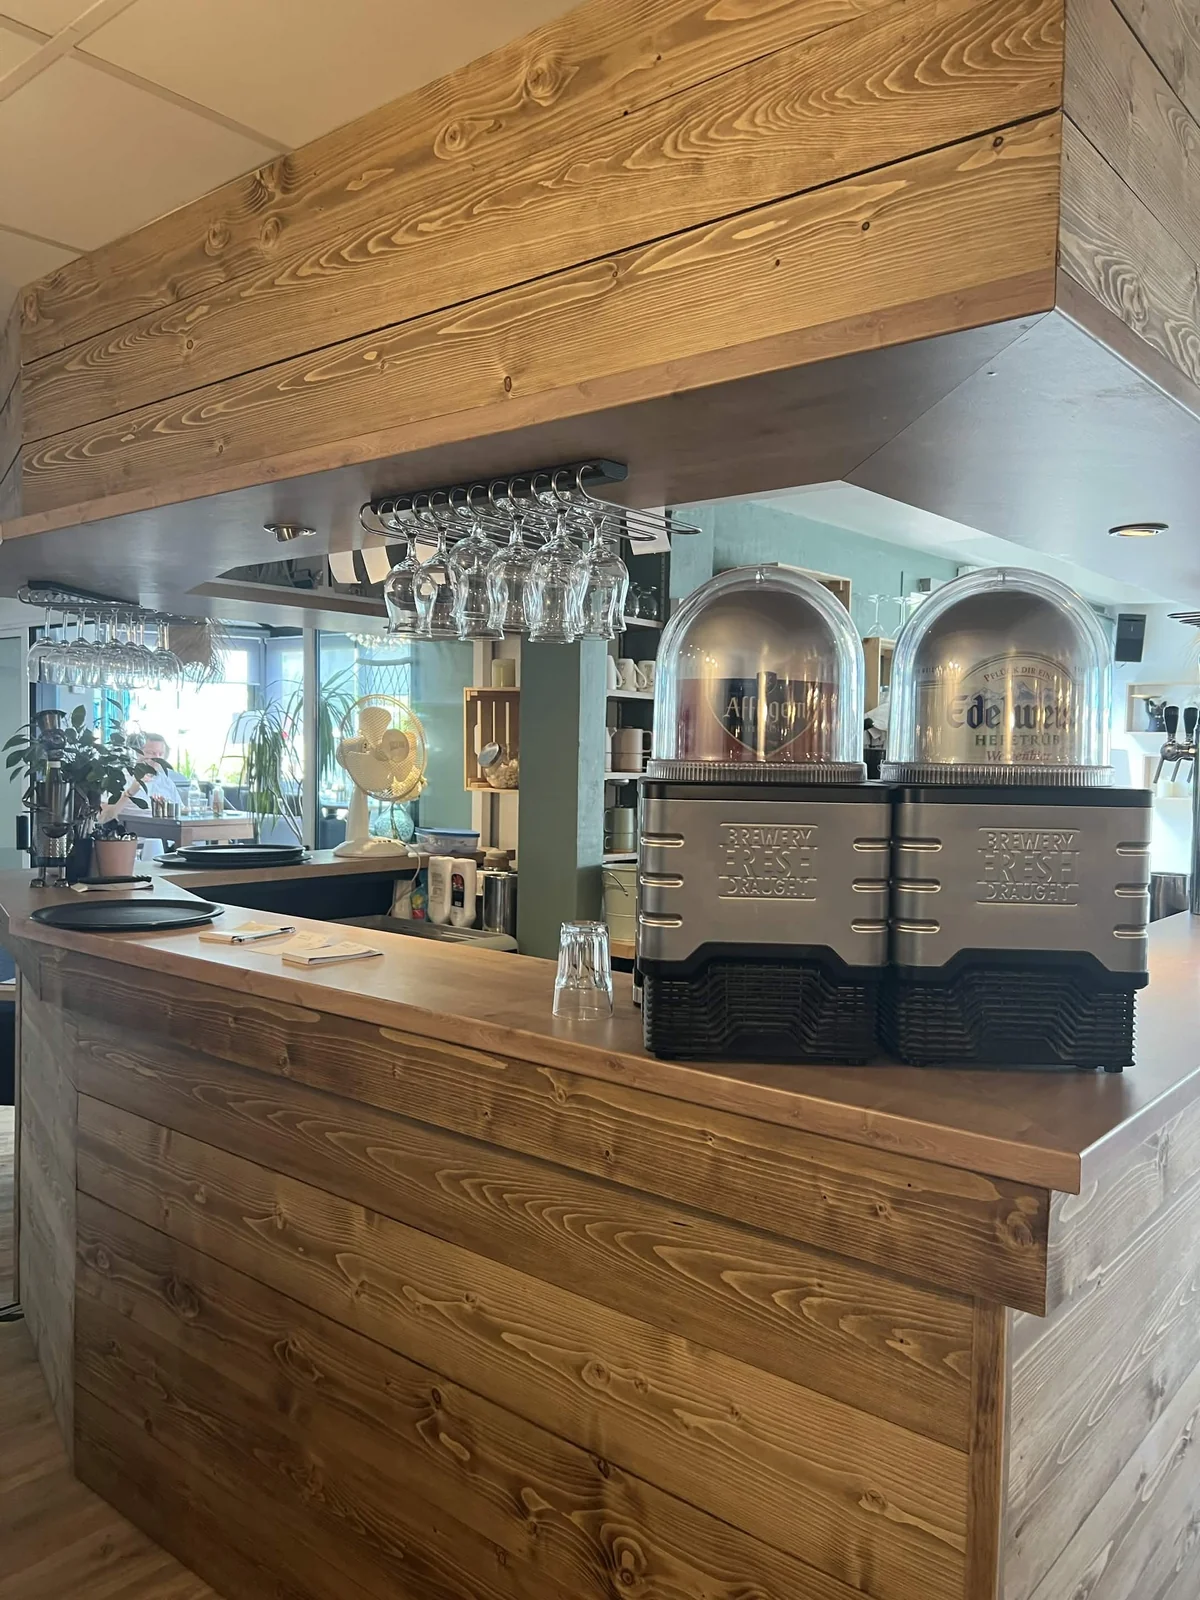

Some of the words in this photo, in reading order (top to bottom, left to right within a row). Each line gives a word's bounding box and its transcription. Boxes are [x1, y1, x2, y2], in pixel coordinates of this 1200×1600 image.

[984, 667, 1019, 682] PFLÜK
[1022, 666, 1037, 675] DIR
[722, 696, 806, 723] Affgem
[728, 827, 812, 846] BREWERY
[987, 832, 1073, 851] BREWERY
[721, 846, 816, 879] FRESH
[980, 851, 1078, 884] FRESH
[727, 878, 810, 896] DRAUGHT
[985, 883, 1069, 901] DRAUGHT
